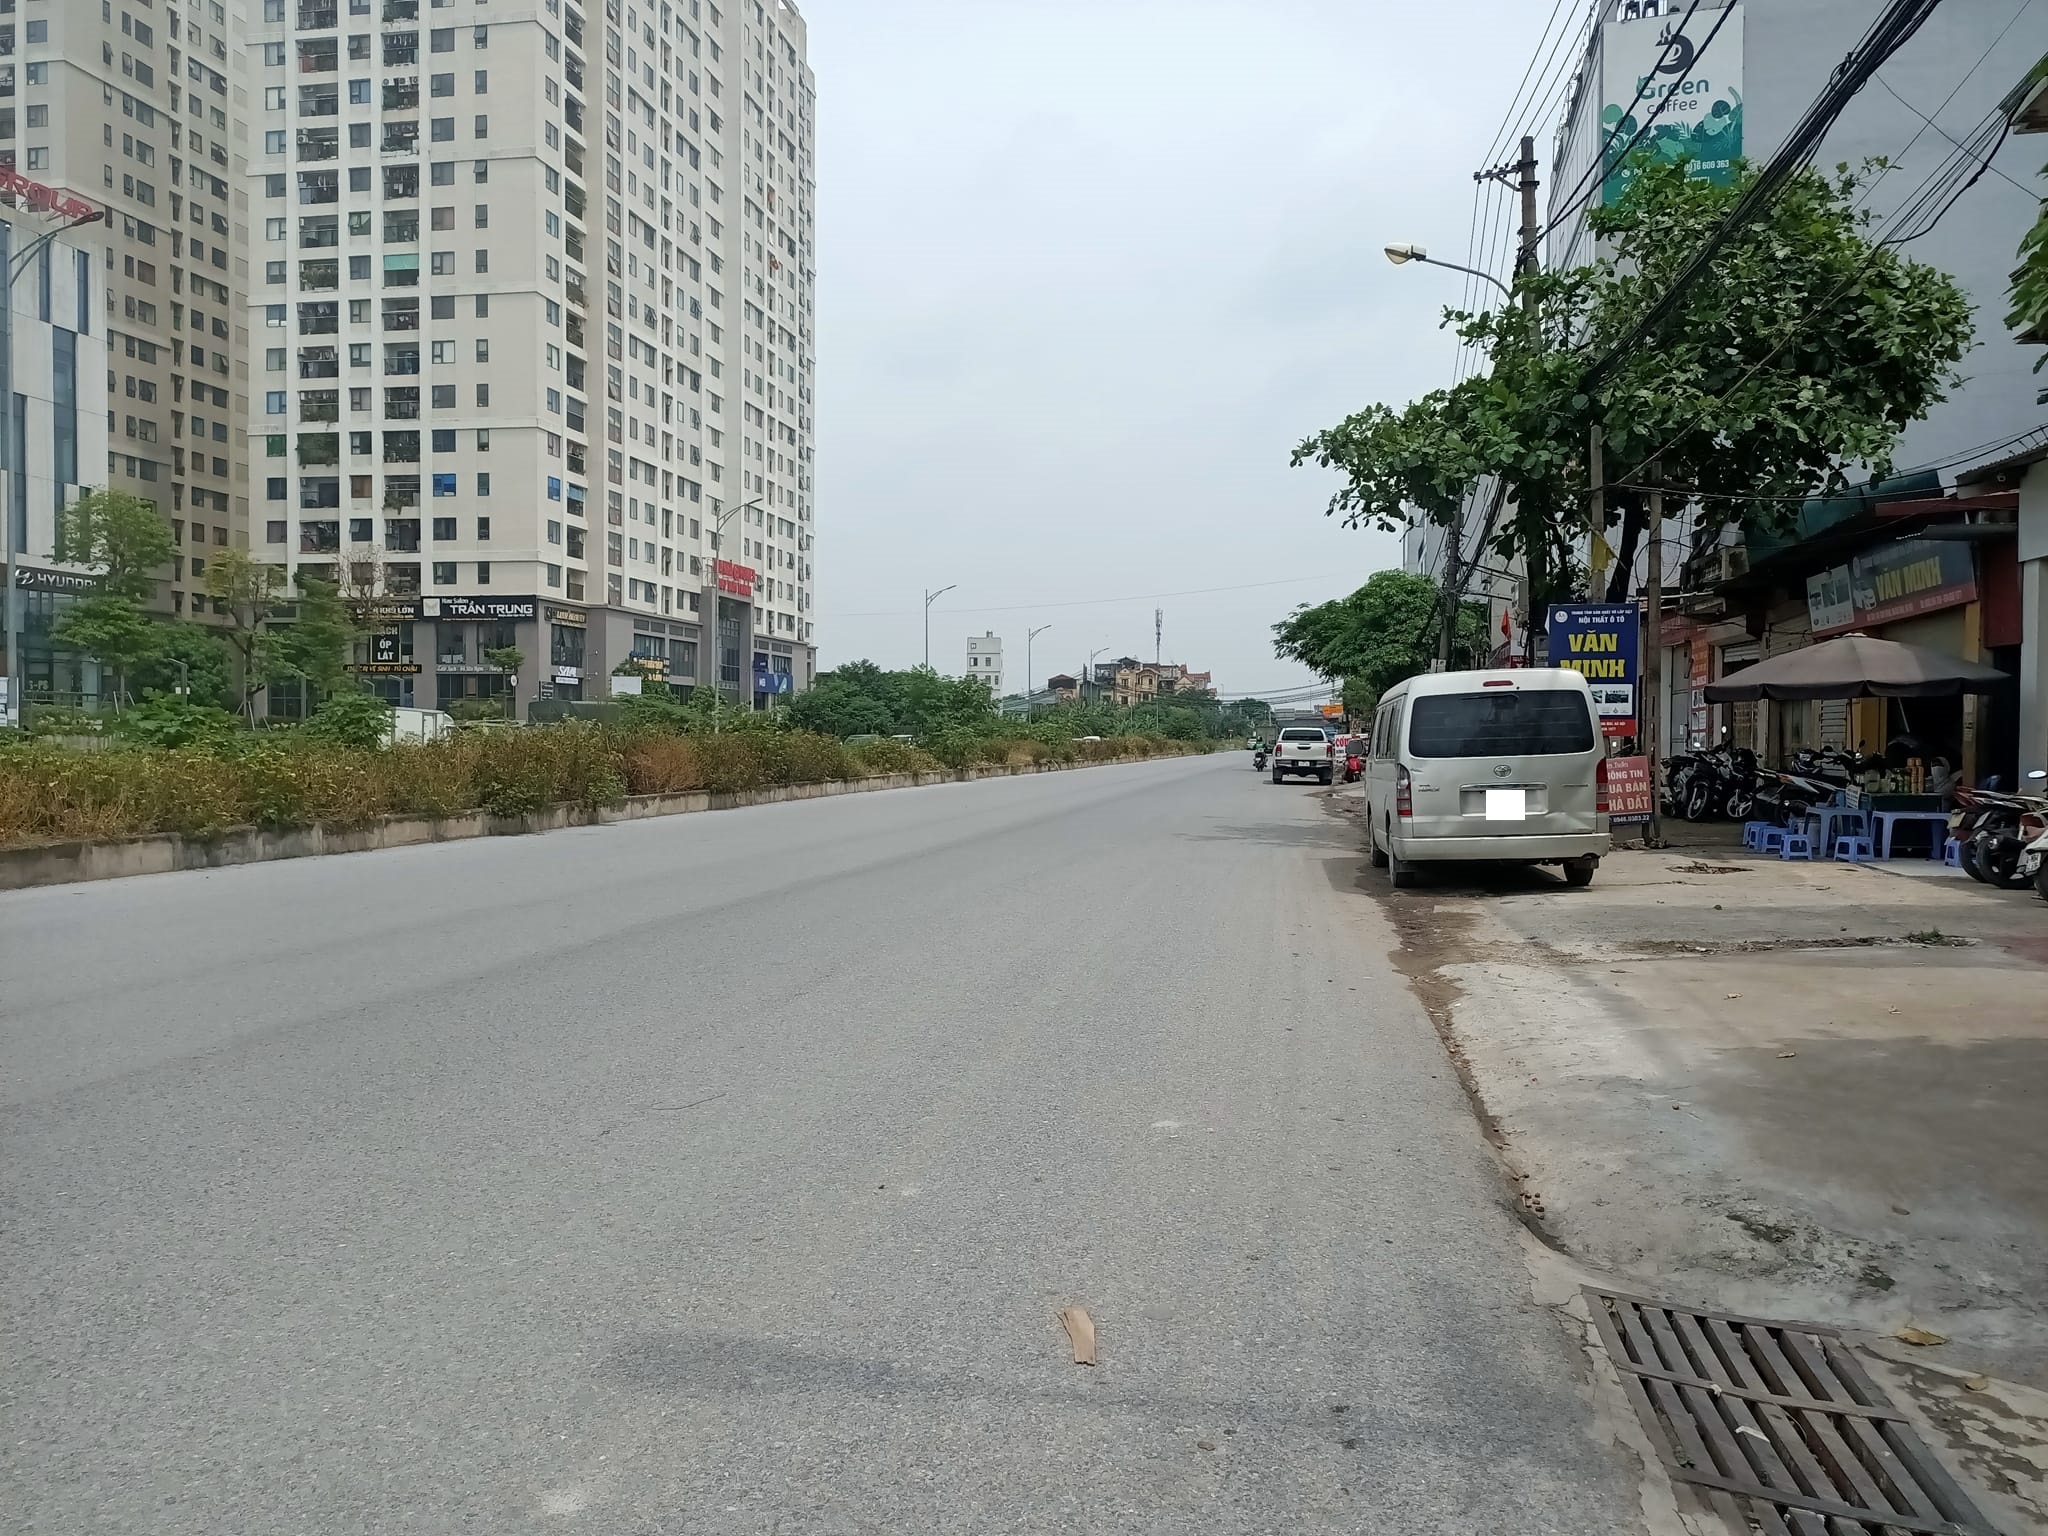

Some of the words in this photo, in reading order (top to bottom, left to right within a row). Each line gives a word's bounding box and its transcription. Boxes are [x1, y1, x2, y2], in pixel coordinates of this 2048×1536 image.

[1636, 76, 1709, 99] Green
[1647, 99, 1698, 115] coffee
[37, 572, 97, 590] HYUNDA
[487, 604, 533, 614] TRUNG
[1568, 628, 1617, 652] VĂN
[1609, 782, 1623, 794] UA
[1609, 795, 1624, 811] HÀ
